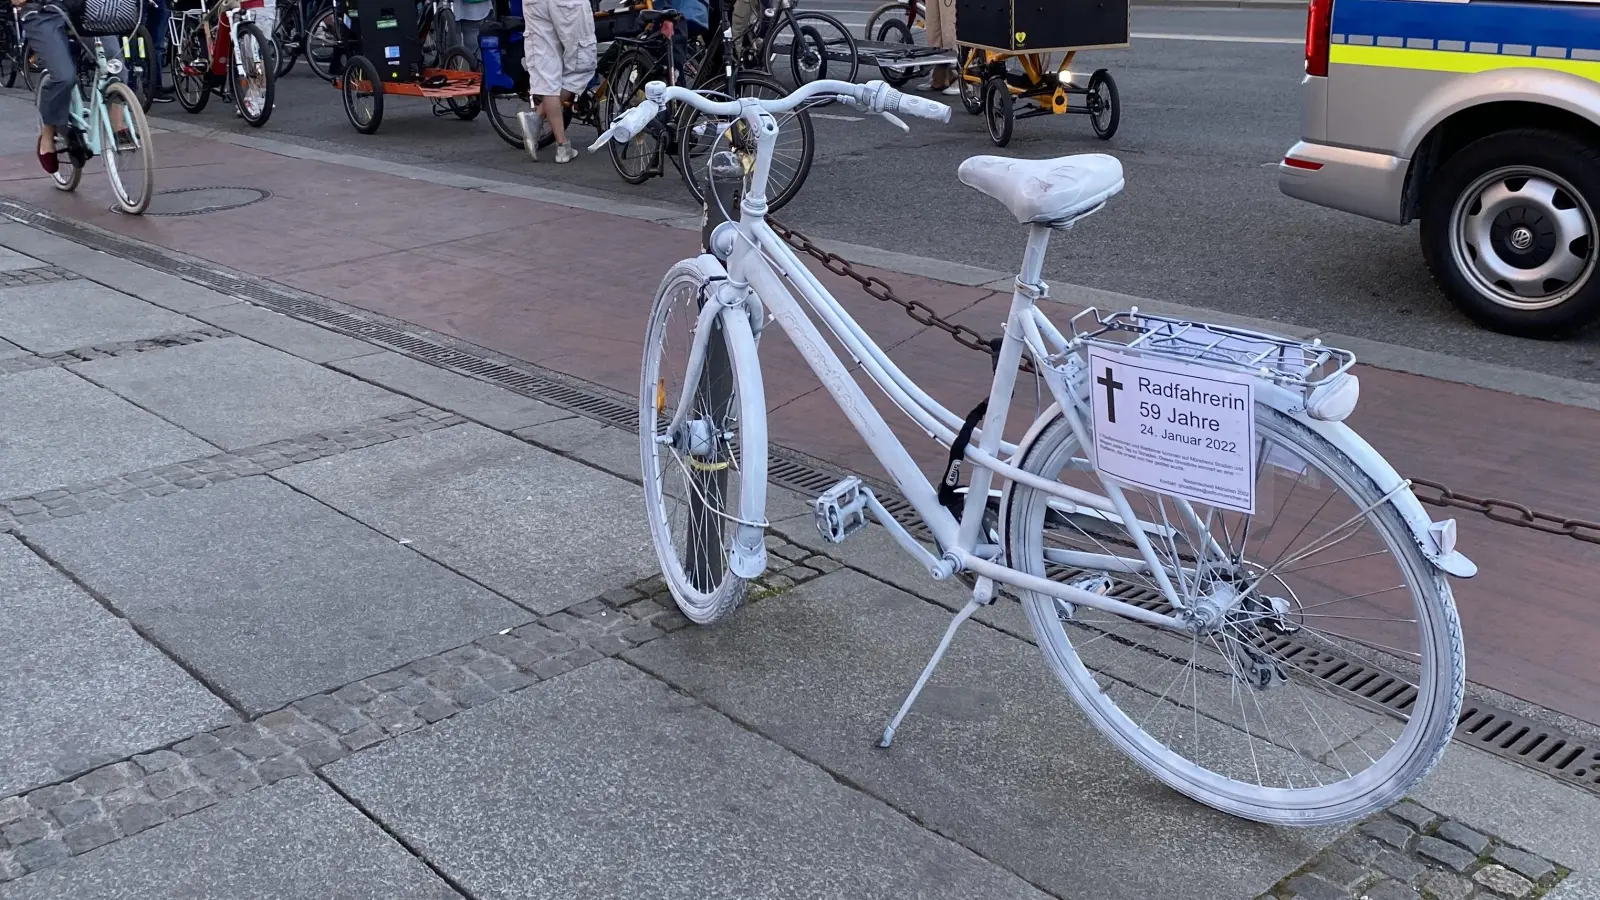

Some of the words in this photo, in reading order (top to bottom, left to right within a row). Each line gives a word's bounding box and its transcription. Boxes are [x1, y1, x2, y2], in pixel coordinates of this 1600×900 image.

[1139, 376, 1244, 411] Radfahrerin
[1140, 401, 1160, 420] 59
[1168, 408, 1220, 432] Jahre
[1140, 424, 1158, 437] 24.
[1161, 429, 1201, 446] Januar
[1205, 438, 1236, 453] 2022
